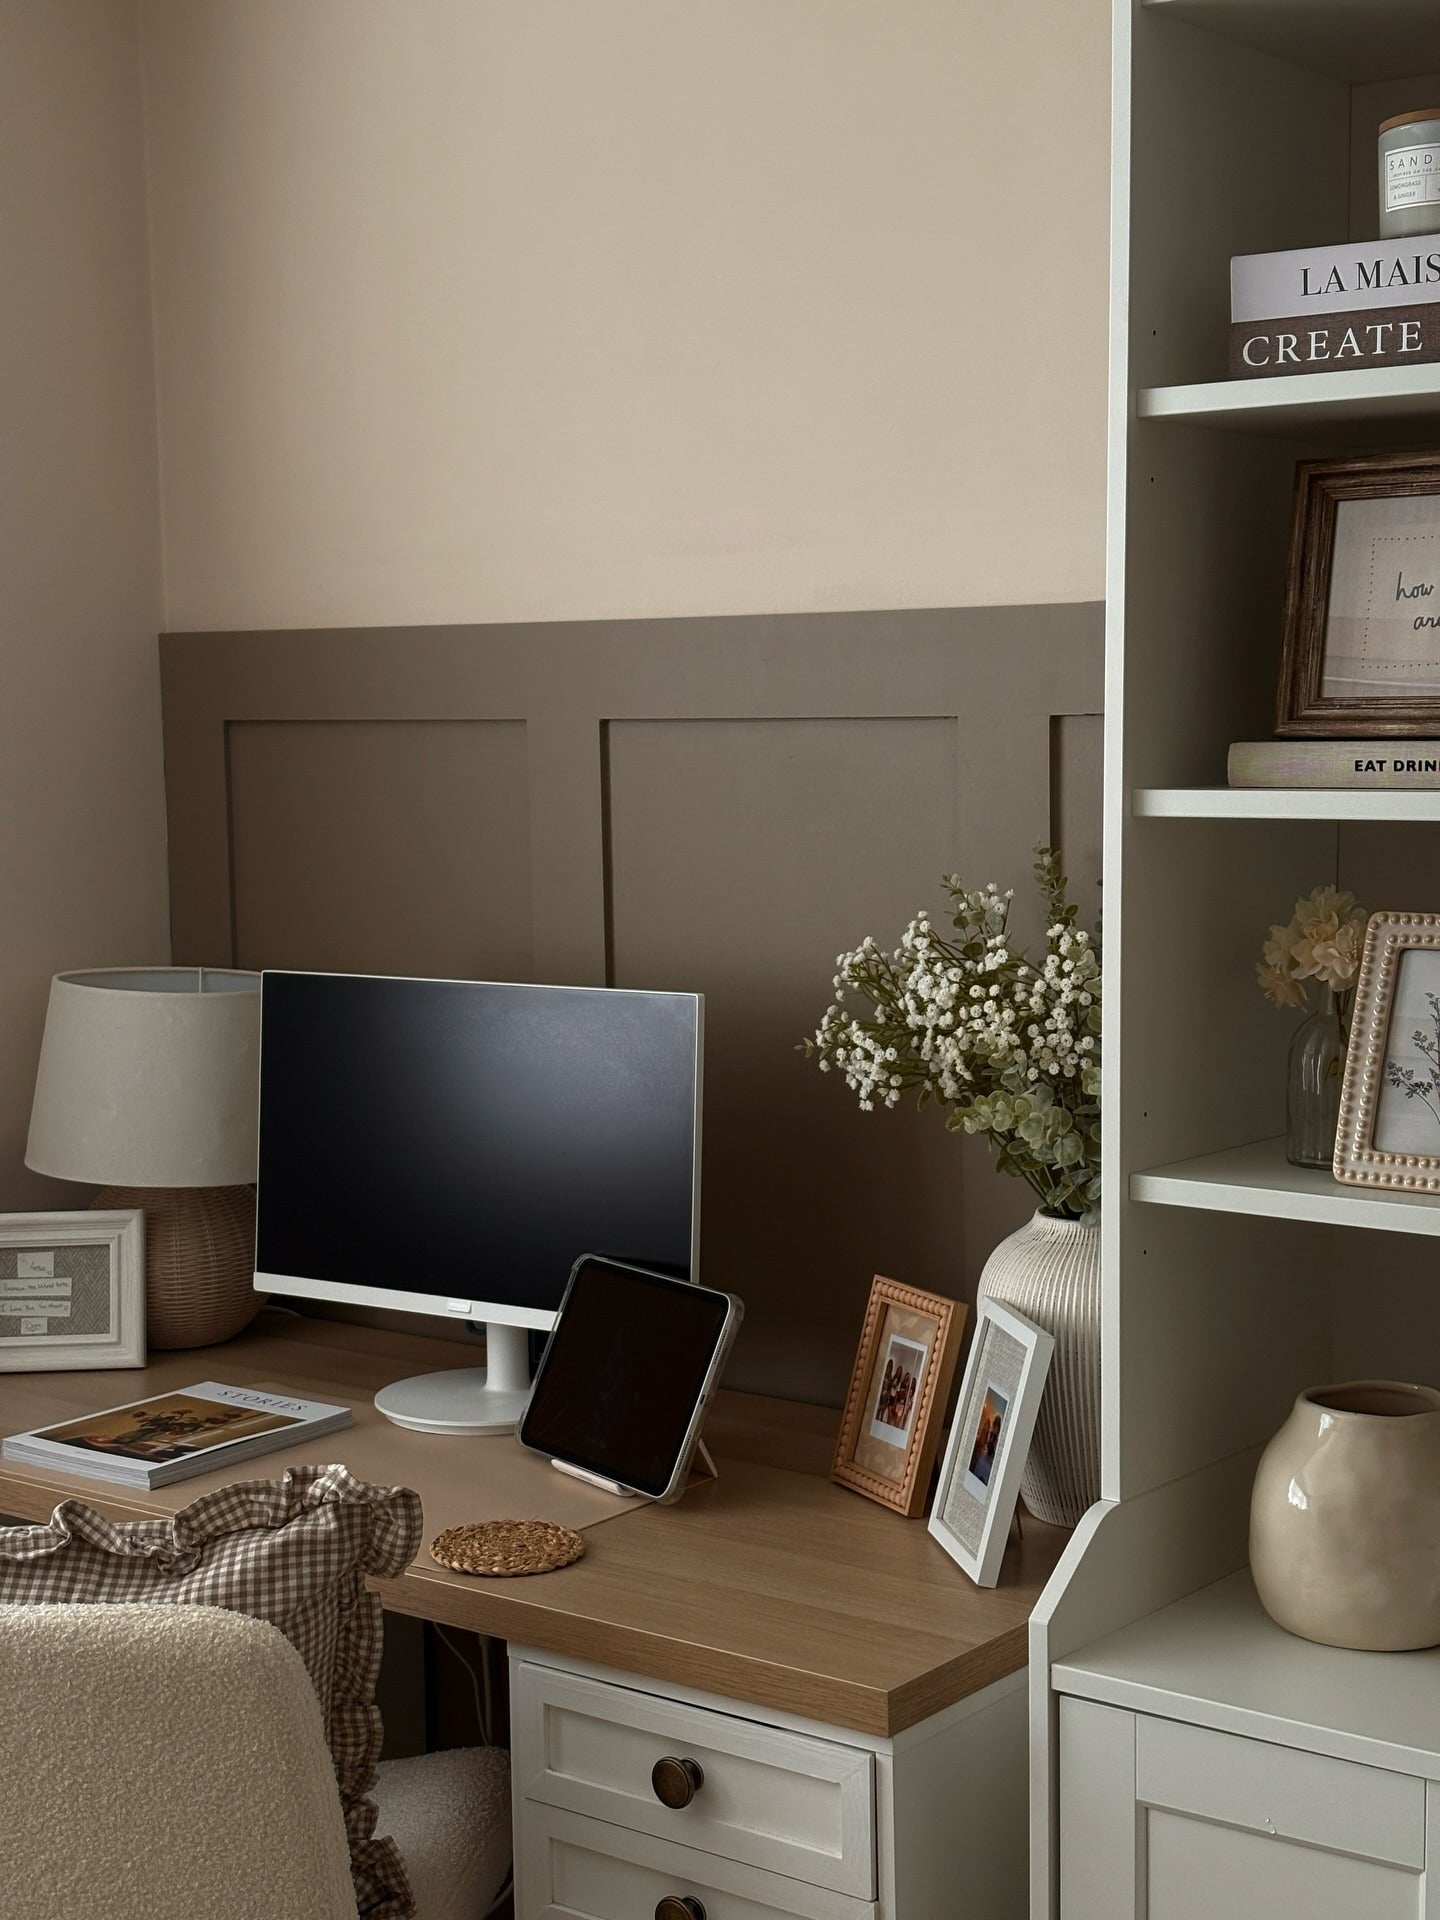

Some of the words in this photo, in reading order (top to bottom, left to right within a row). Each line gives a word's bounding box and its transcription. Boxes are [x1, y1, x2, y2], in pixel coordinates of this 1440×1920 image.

[1390, 154, 1433, 171] SAND
[1300, 265, 1348, 296] LA
[1355, 253, 1440, 290] MAIS
[1242, 321, 1423, 366] CREATE
[1395, 571, 1435, 601] how
[1354, 759, 1387, 772] EAT
[1393, 759, 1440, 772] DRIN
[217, 1390, 308, 1410] STORIES
